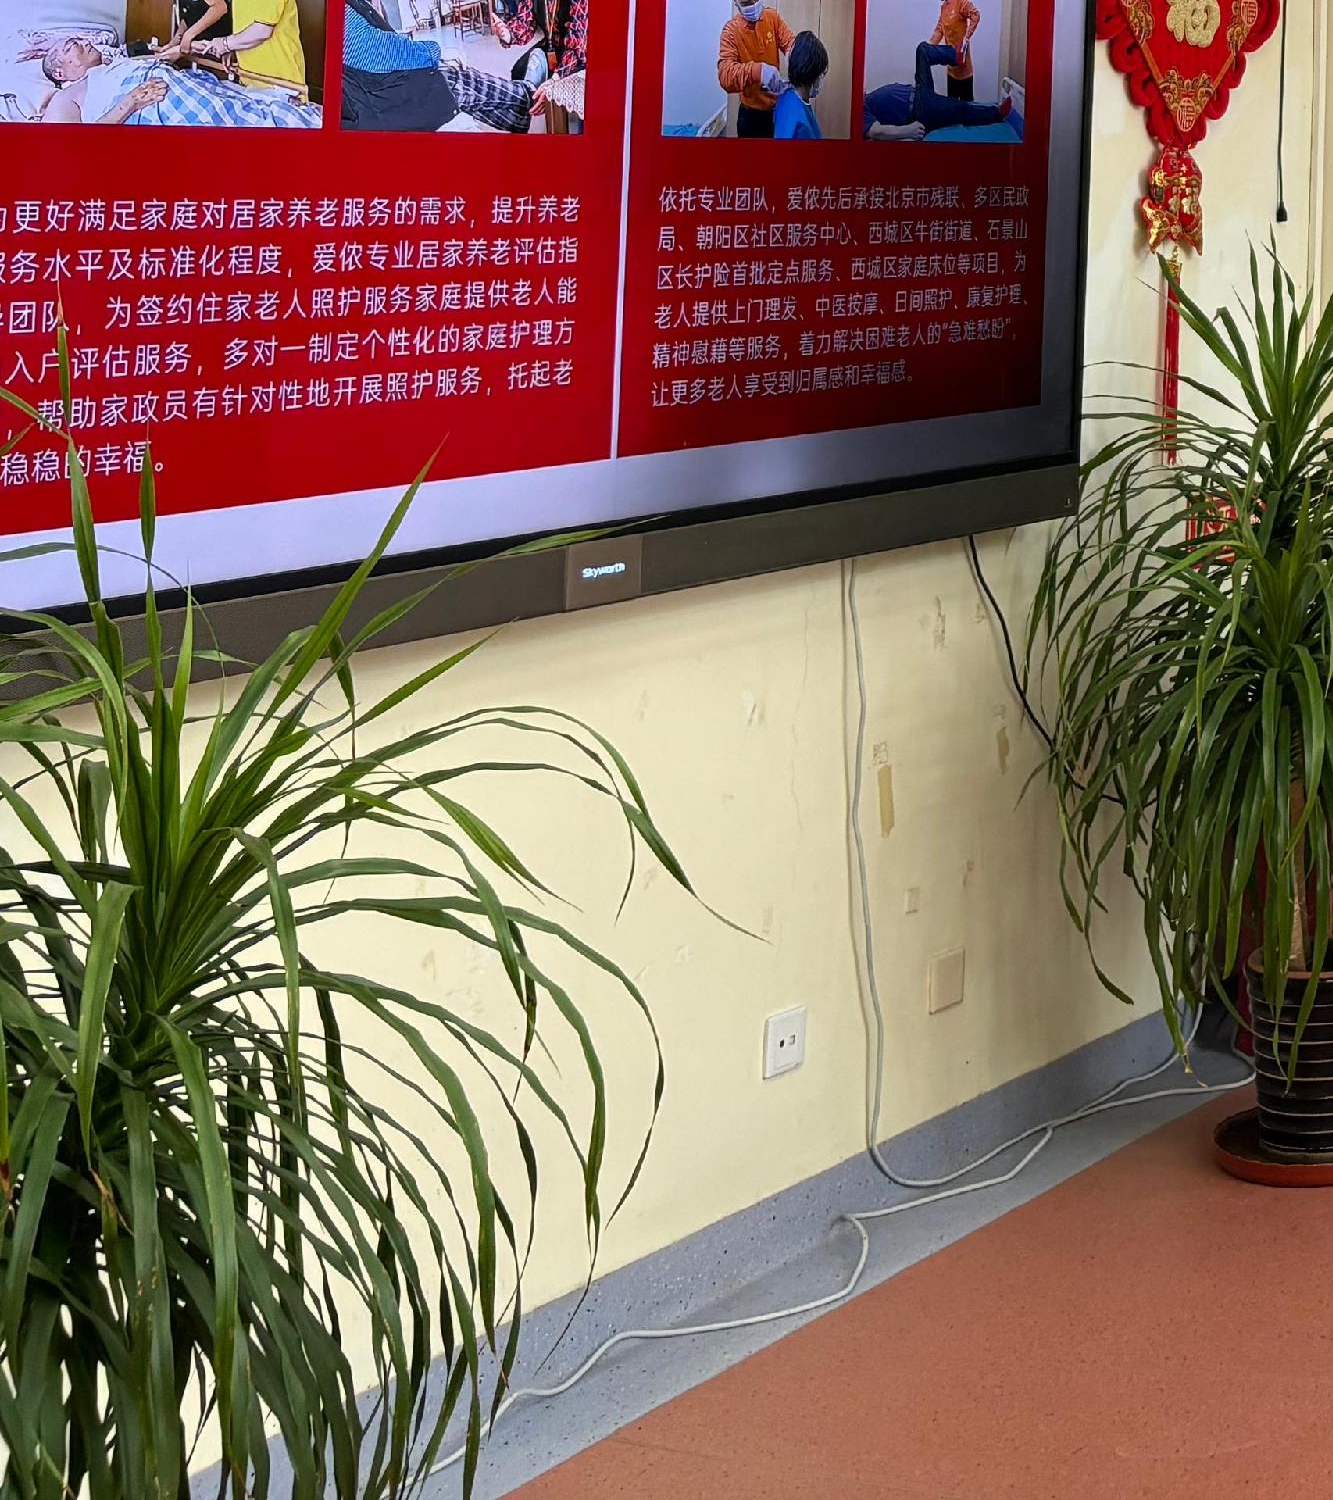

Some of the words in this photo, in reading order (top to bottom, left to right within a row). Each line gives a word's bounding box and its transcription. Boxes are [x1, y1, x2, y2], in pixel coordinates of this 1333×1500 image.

[0, 195, 581, 234] 更好满足家庭对居家养老服务的需求，提升养老
[658, 184, 1031, 215] 依托专业团队，爱侬先后承接北京市残联、多区民政
[656, 217, 1030, 253] 局、朝阳区社区服务中心、西城区牛街街道、石景山
[0, 235, 580, 285] 务水平及标准化程度，爱侬专业居家养老评估指
[0, 276, 578, 336] 团队，为签约住家老人照护服务家庭提供老人能
[650, 358, 914, 408] 让更多老人享受到归属感和幸福感。
[582, 562, 626, 579] Skyworth
